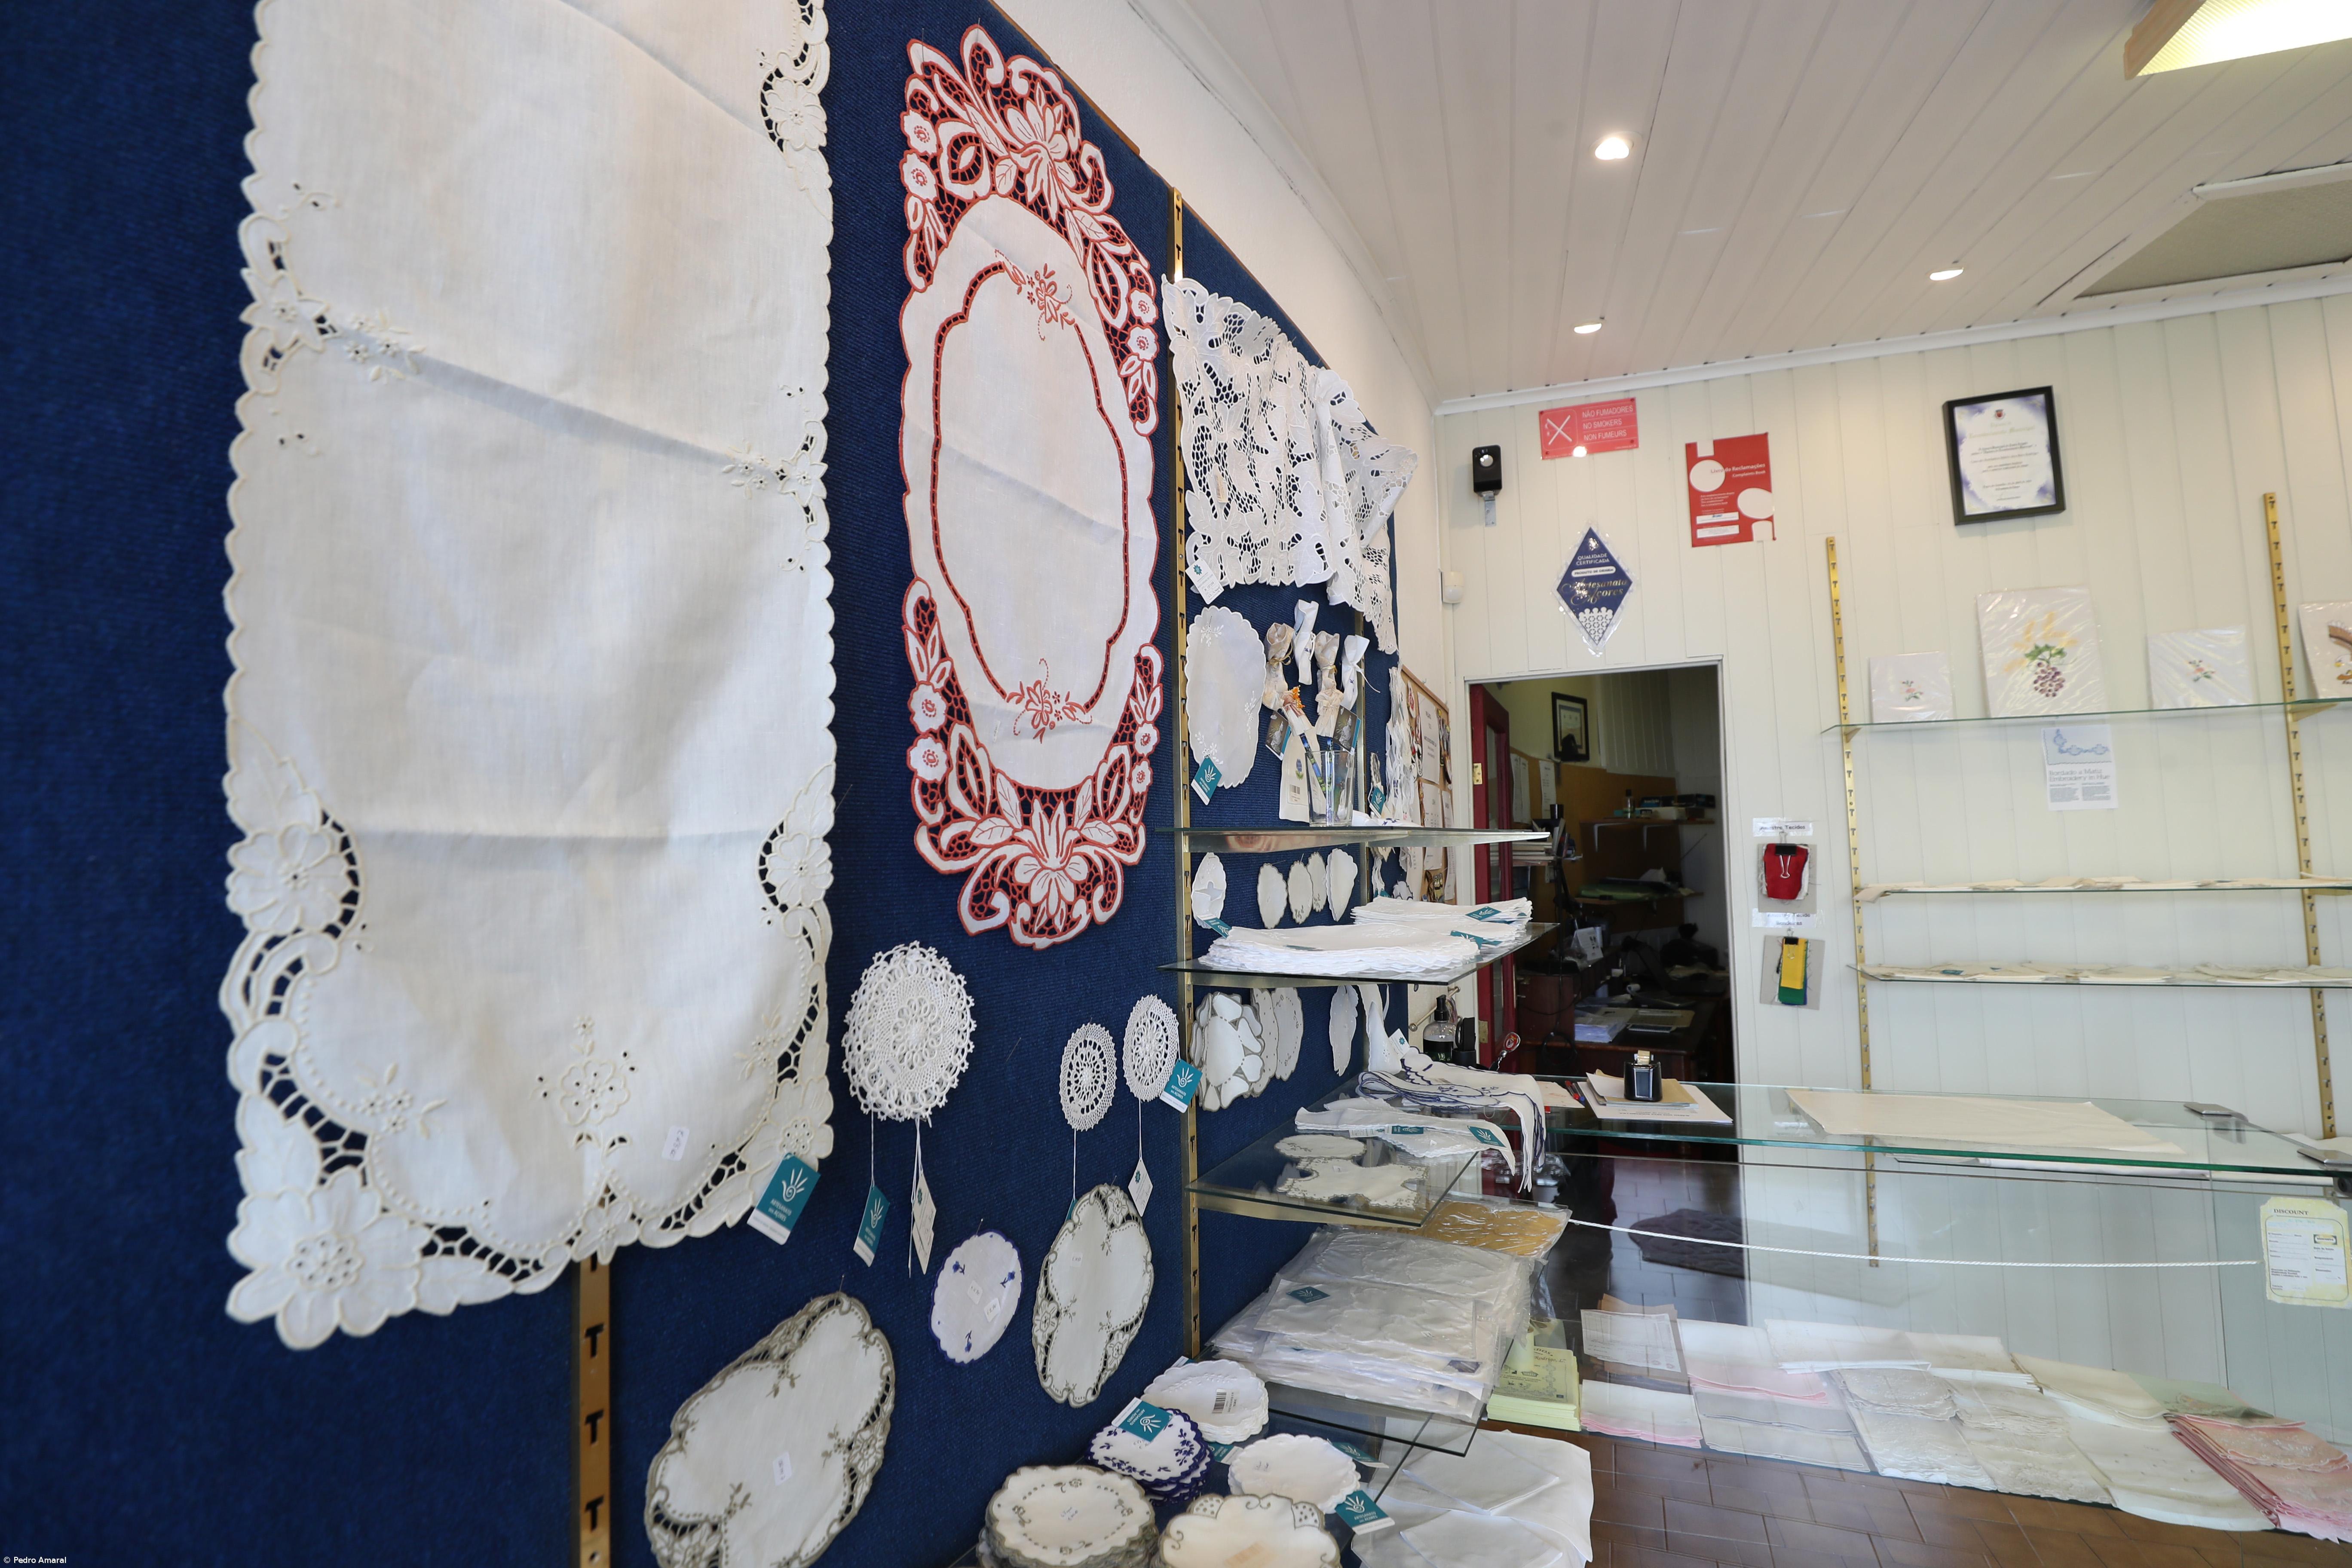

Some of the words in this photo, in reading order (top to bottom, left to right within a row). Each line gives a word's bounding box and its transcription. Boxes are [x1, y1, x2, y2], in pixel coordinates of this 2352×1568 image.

[1596, 405, 1633, 416] FUMADORES
[1593, 418, 1622, 428] SMOKERS
[1598, 429, 1627, 438] FUMEURS
[1732, 463, 1766, 471] Reclamações
